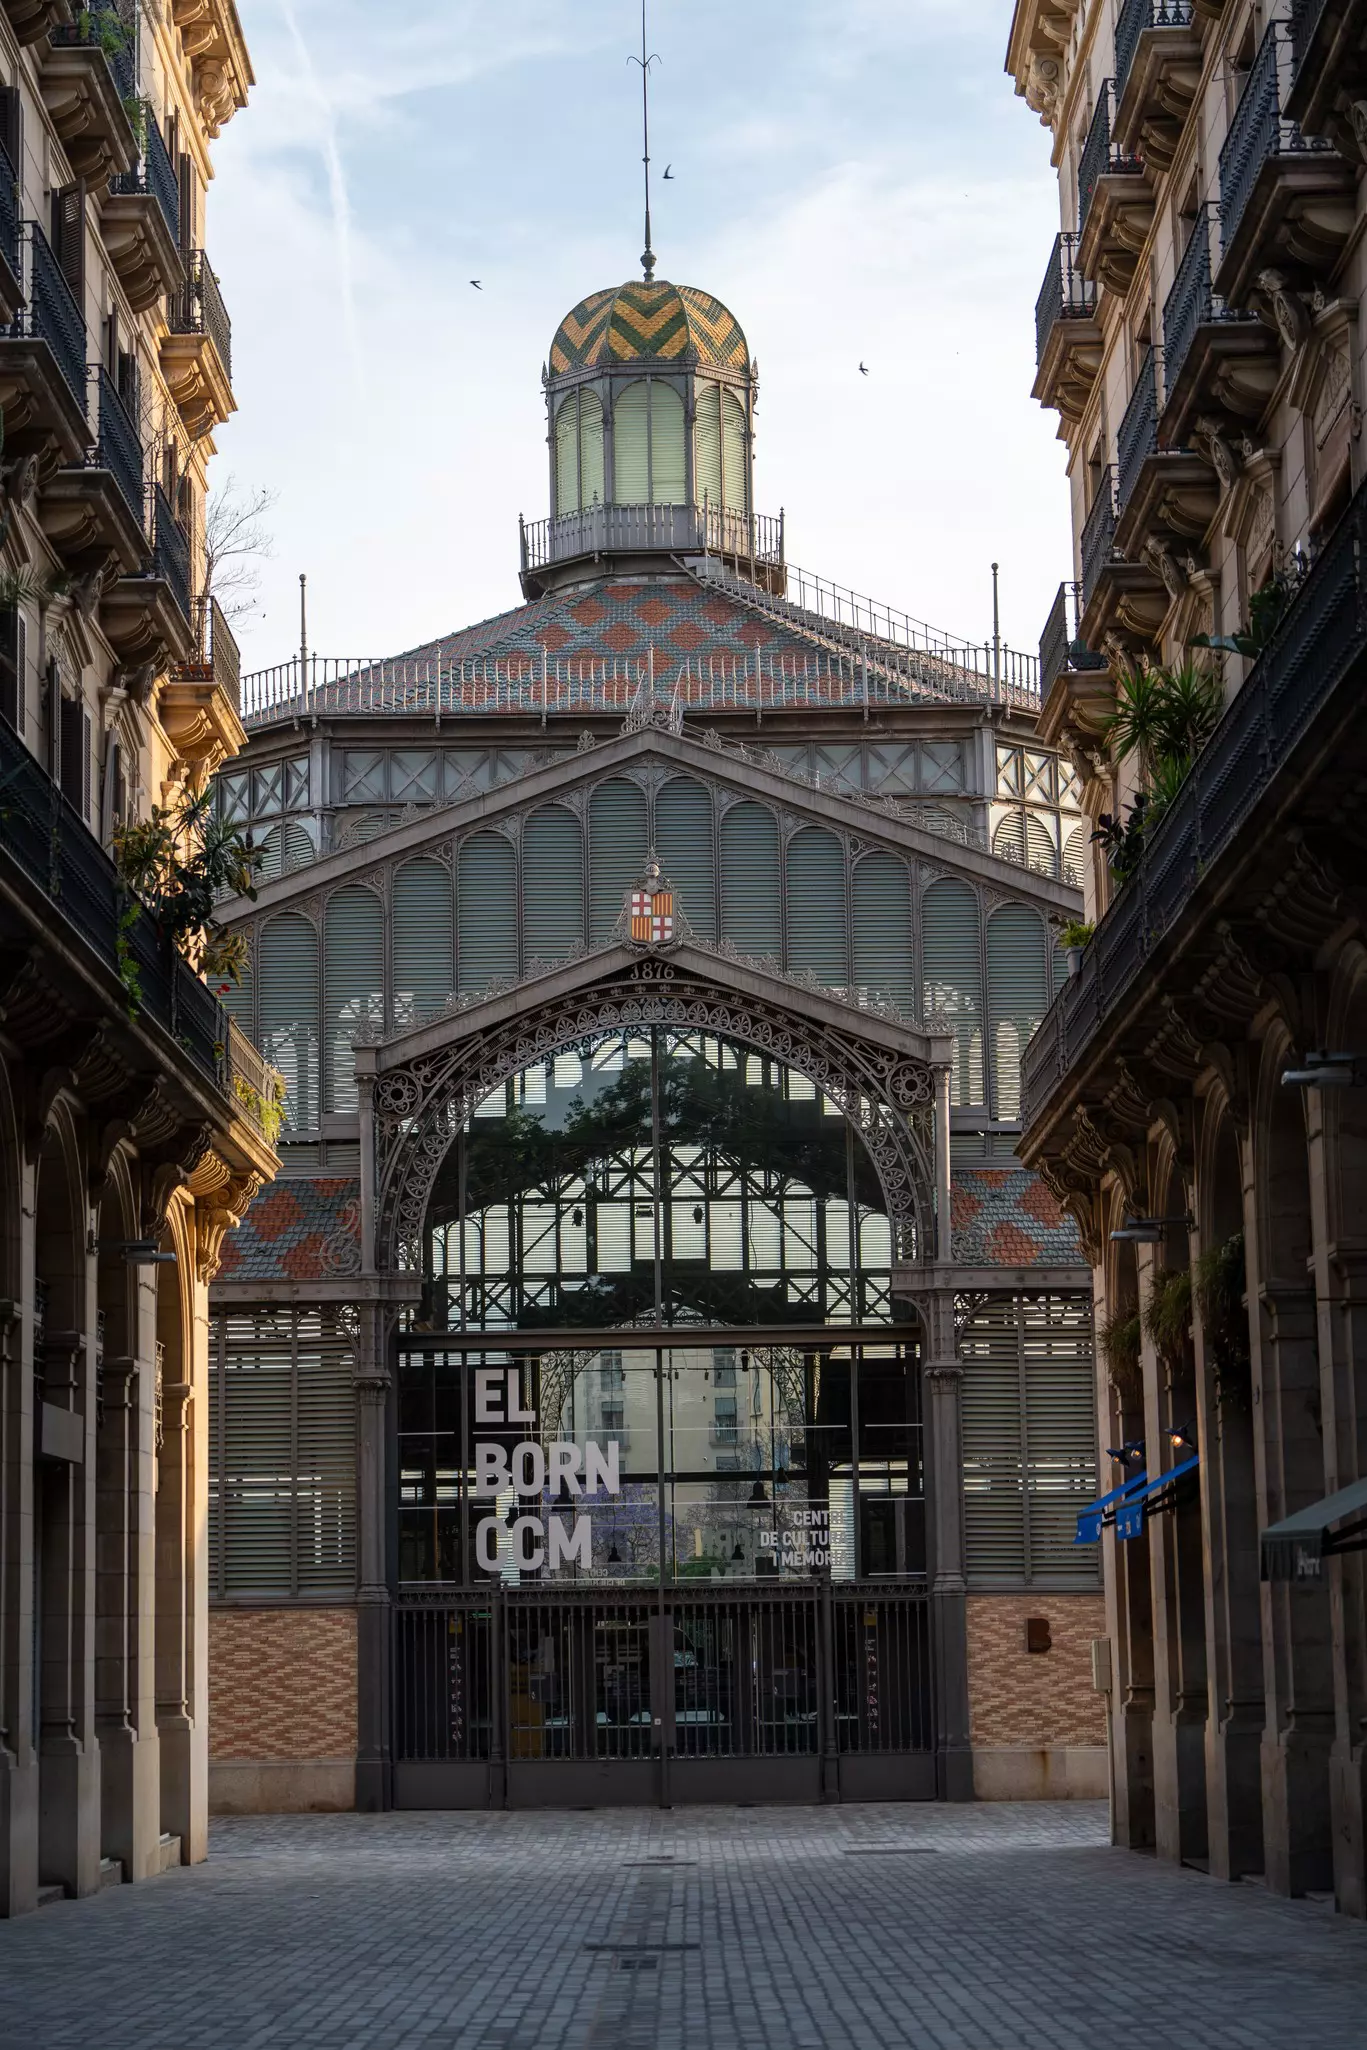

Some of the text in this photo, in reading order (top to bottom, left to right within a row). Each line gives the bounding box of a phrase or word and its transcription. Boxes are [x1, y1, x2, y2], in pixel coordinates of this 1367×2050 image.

[630, 962, 675, 980] 1876
[475, 1369, 536, 1422] EL
[475, 1440, 620, 1497] BORN
[475, 1515, 592, 1572] CCM
[760, 1531, 779, 1547] DE
[773, 1551, 777, 1566] I
[1027, 1617, 1052, 1653] B
